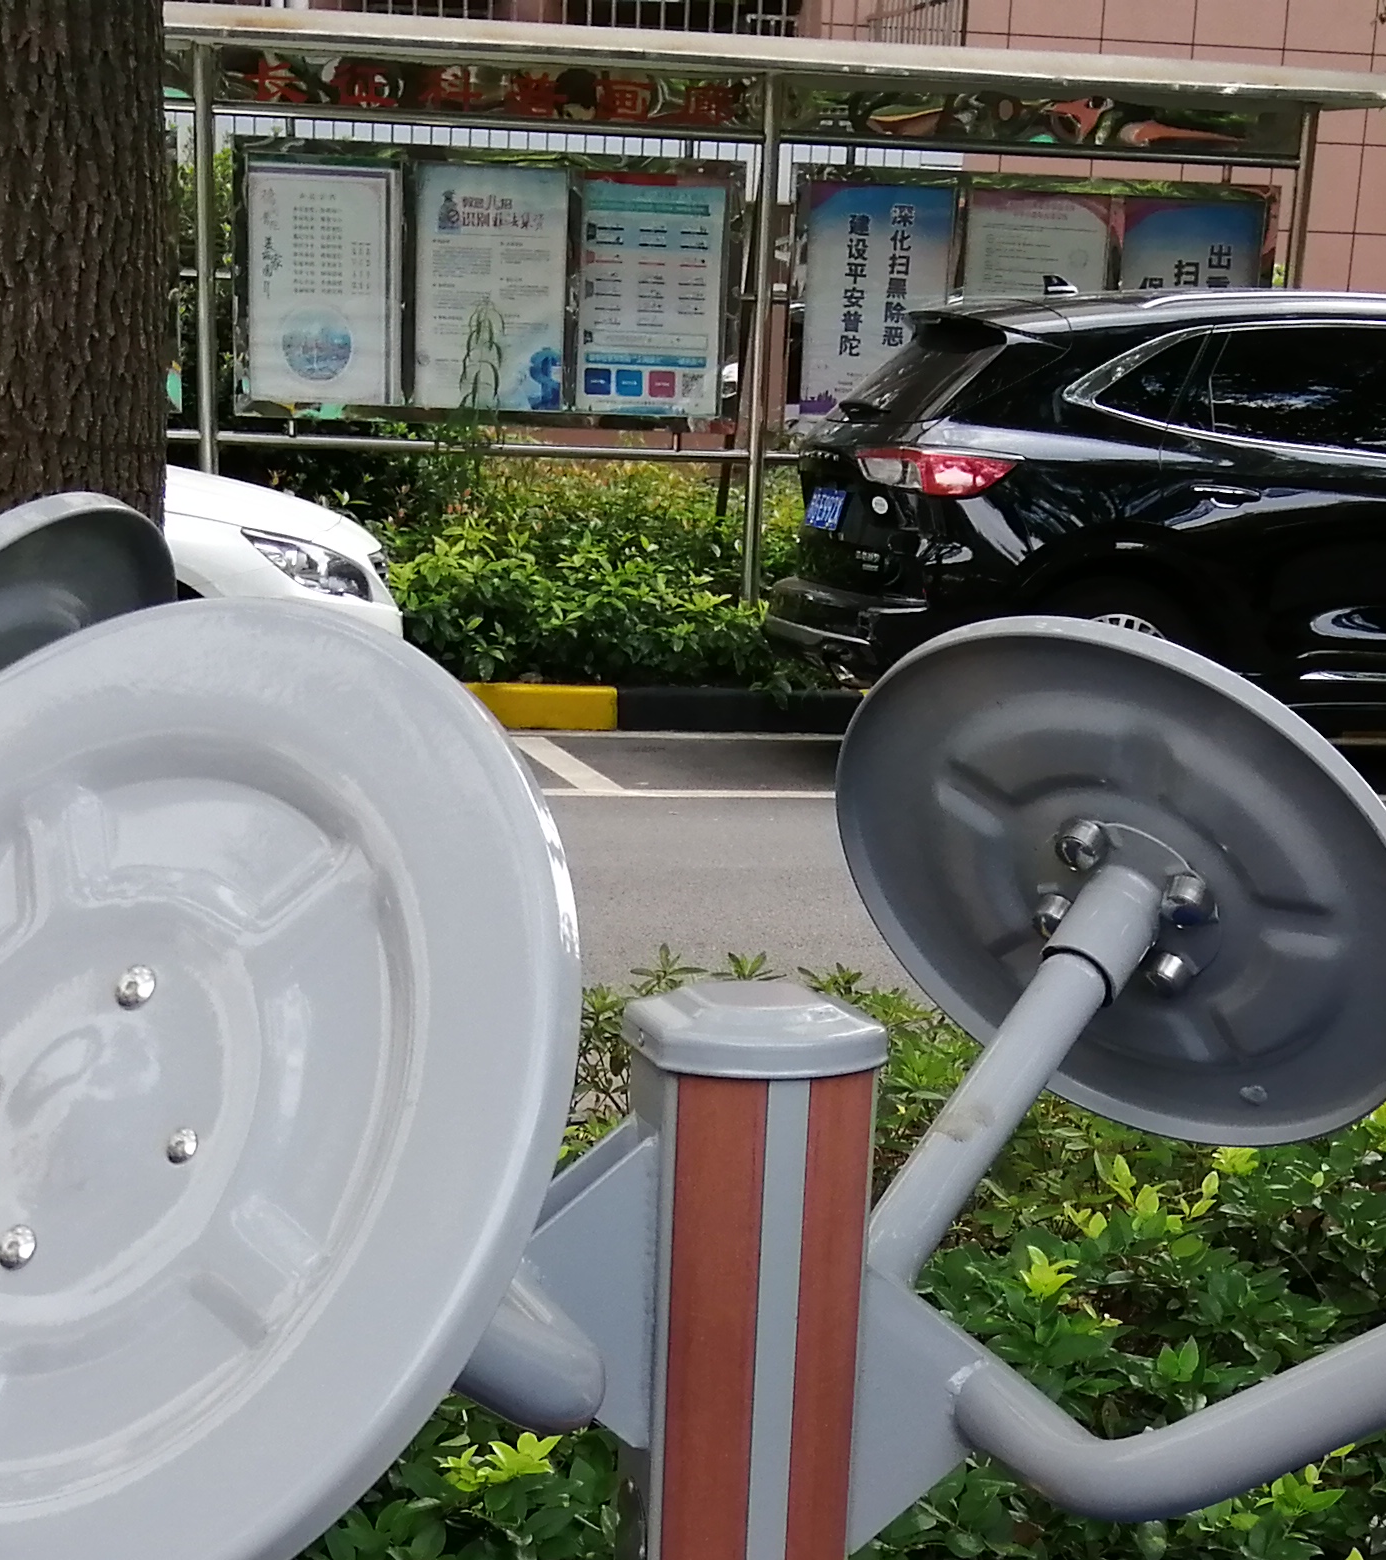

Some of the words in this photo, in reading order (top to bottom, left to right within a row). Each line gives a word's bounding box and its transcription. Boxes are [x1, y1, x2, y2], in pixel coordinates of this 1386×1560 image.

[244, 58, 739, 126] 长征科普画廊
[838, 213, 872, 358] 建设平安普陀
[881, 203, 915, 348] 深化扫黑除恶
